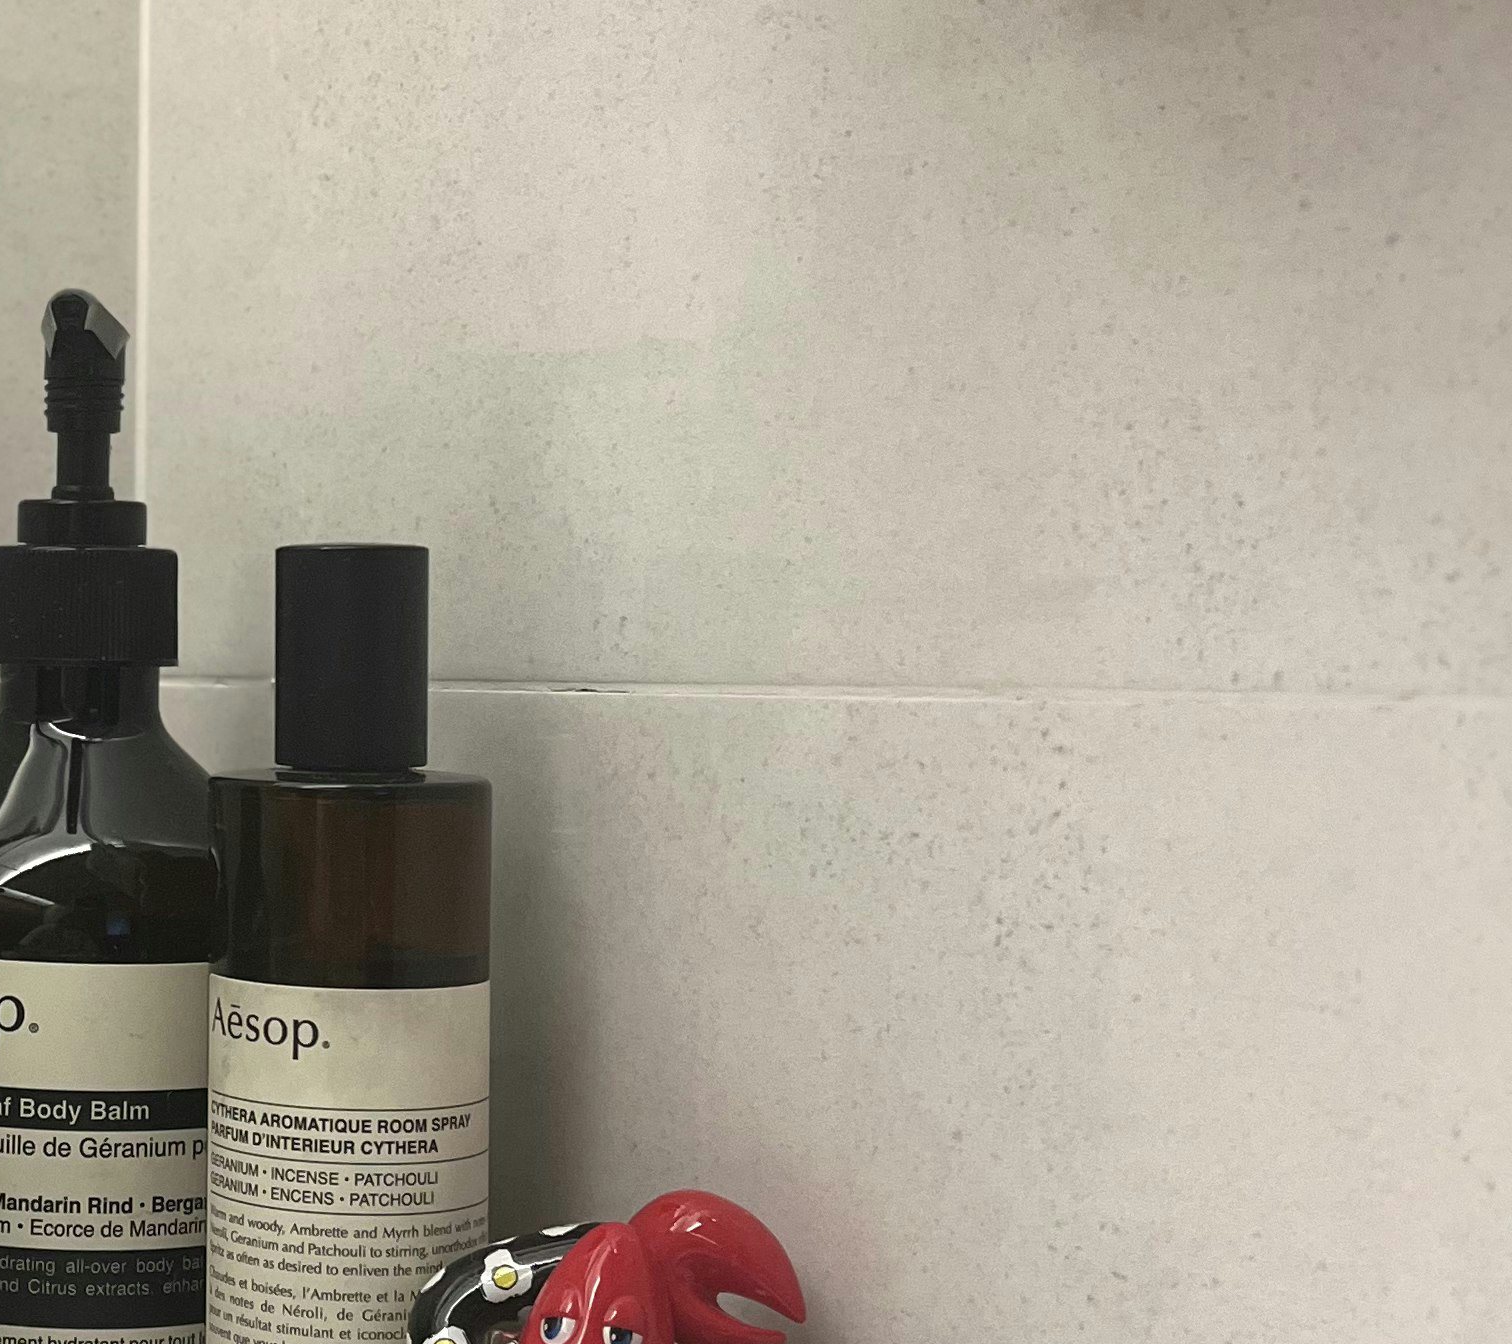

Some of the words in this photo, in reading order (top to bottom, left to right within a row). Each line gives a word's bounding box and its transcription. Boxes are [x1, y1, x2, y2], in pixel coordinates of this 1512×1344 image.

[19, 1098, 82, 1125] Body
[90, 1100, 150, 1121] Balm
[210, 1100, 257, 1125] CYTHERA
[260, 1112, 372, 1133] AROMATIQUE
[377, 1118, 427, 1133] ROOM
[431, 1113, 471, 1132] SPRAY
[42, 1137, 71, 1157] de
[79, 1137, 186, 1158] Géranium
[192, 1139, 206, 1160] p
[211, 1120, 249, 1144] PARFUM
[252, 1132, 355, 1155] D'INTERIEUR
[360, 1139, 439, 1155] CYTHERA
[210, 1151, 259, 1177] GERANIUM
[271, 1166, 340, 1186] INCENSE
[354, 1171, 438, 1187] PATCHOULI
[210, 1171, 259, 1197] GERANIUM
[270, 1187, 335, 1206] ENCENS
[349, 1191, 435, 1207] PATCHOULI
[88, 1197, 133, 1214] Rind
[30, 1218, 95, 1238] Ecorce
[100, 1220, 124, 1238] de
[228, 1213, 245, 1226] and
[247, 1219, 285, 1236] woody,
[289, 1223, 349, 1238] Ambrette
[353, 1226, 378, 1239] and
[382, 1225, 419, 1242] Myrrh
[423, 1222, 452, 1236] blend
[230, 1230, 279, 1251] Geranium
[281, 1241, 305, 1254] and
[308, 1243, 367, 1258] Patchouli
[370, 1246, 383, 1258] to
[65, 1258, 127, 1274] all-over
[136, 1257, 175, 1276] body
[236, 1251, 260, 1267] often
[263, 1259, 275, 1270] as
[277, 1258, 322, 1275] desired
[326, 1264, 339, 1276] to
[342, 1262, 389, 1277] enliven
[393, 1263, 413, 1275] the
[27, 1278, 77, 1296] Citrus
[238, 1278, 248, 1290] et
[251, 1278, 296, 1299] boisées,
[302, 1286, 372, 1303] l'Ambrette
[376, 1292, 389, 1303] et
[394, 1289, 405, 1303] la
[229, 1295, 254, 1310] notes
[260, 1299, 275, 1314] de
[282, 1304, 328, 1322] Néroli,
[336, 1307, 354, 1321] de
[235, 1314, 272, 1333] résultat
[276, 1323, 334, 1339] stimulant
[339, 1328, 352, 1340] et
